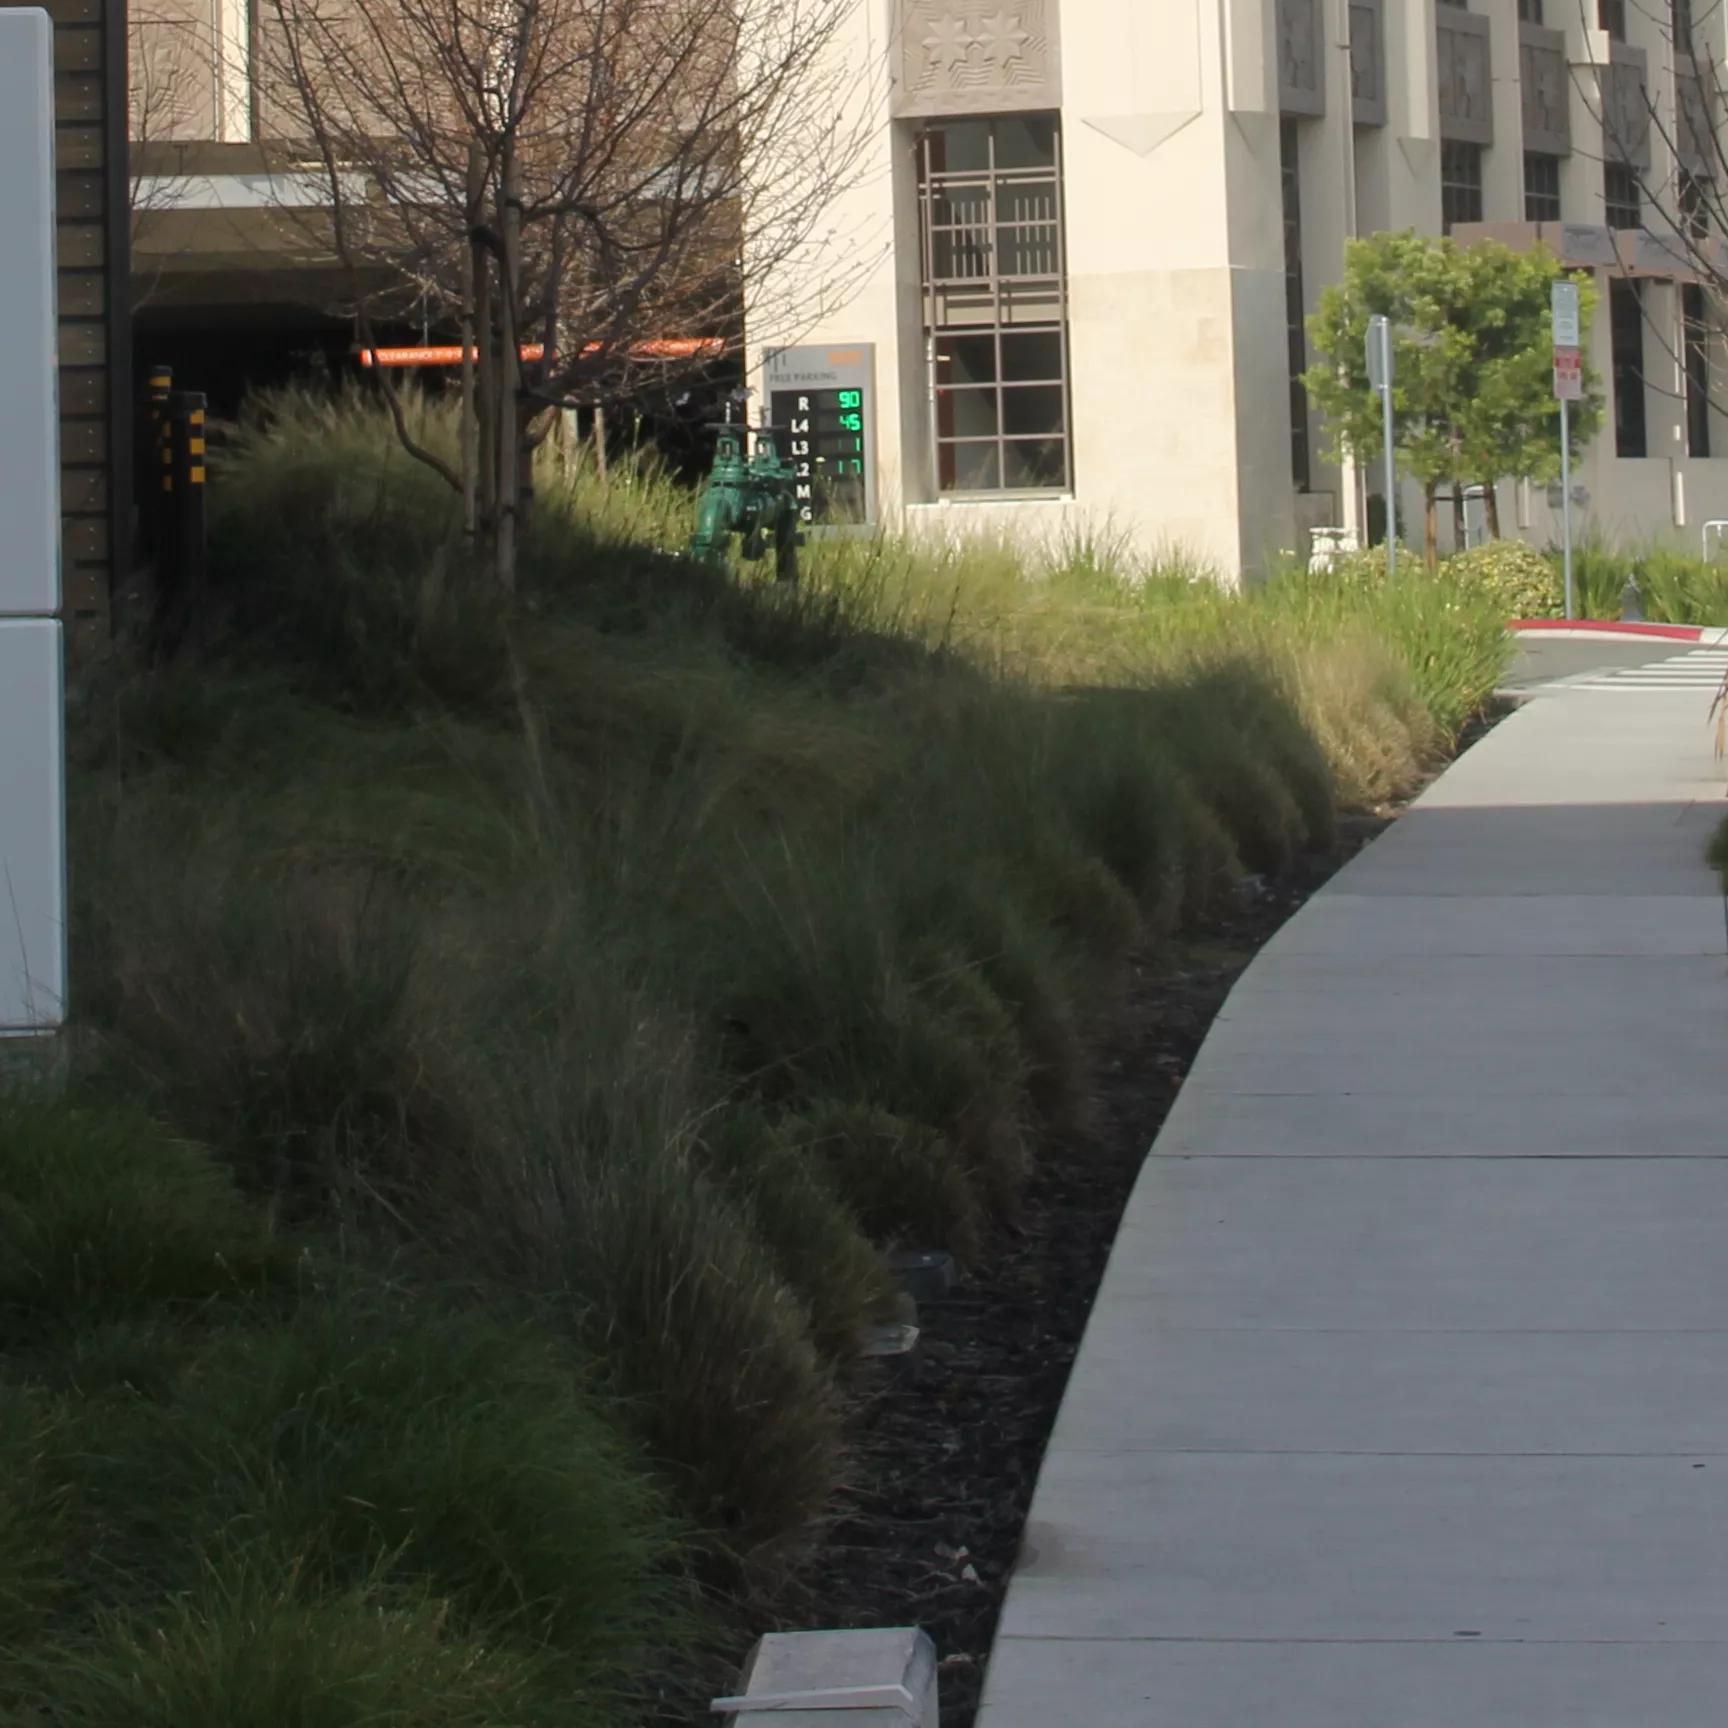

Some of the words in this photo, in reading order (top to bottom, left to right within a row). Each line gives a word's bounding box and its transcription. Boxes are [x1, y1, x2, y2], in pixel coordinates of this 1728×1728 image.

[798, 396, 810, 411] R
[838, 391, 861, 409] 90
[791, 419, 810, 433] L4
[791, 440, 810, 455] L3
[796, 484, 812, 499] M
